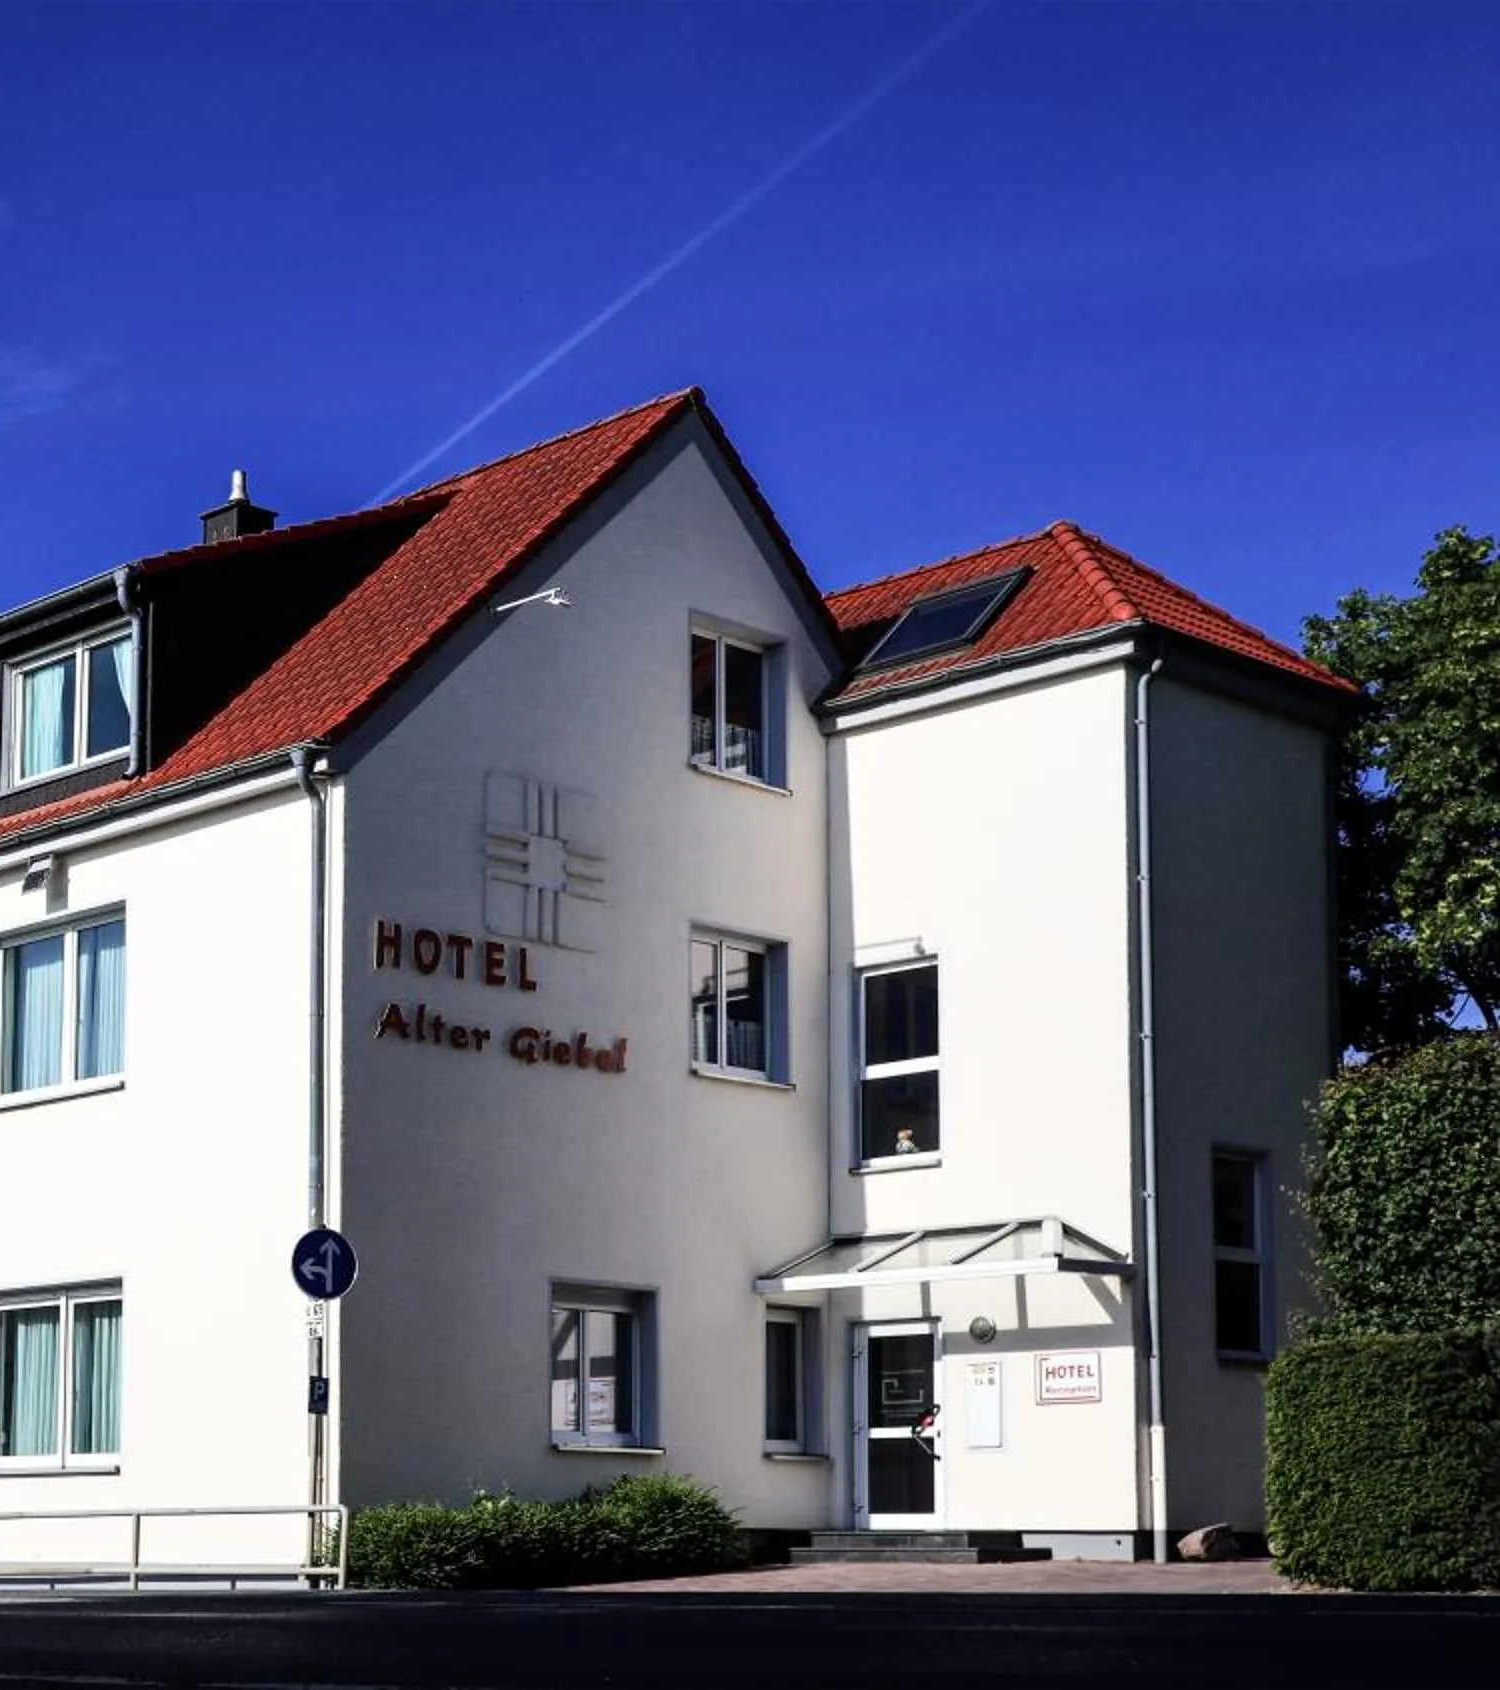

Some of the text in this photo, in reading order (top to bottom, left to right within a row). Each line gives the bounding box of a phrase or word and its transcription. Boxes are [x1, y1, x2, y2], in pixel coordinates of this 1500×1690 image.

[373, 919, 537, 993] HOTEL
[373, 1002, 629, 1074] Alter Giebel
[314, 1380, 325, 1400] P
[1045, 1363, 1096, 1381] HOTEL
